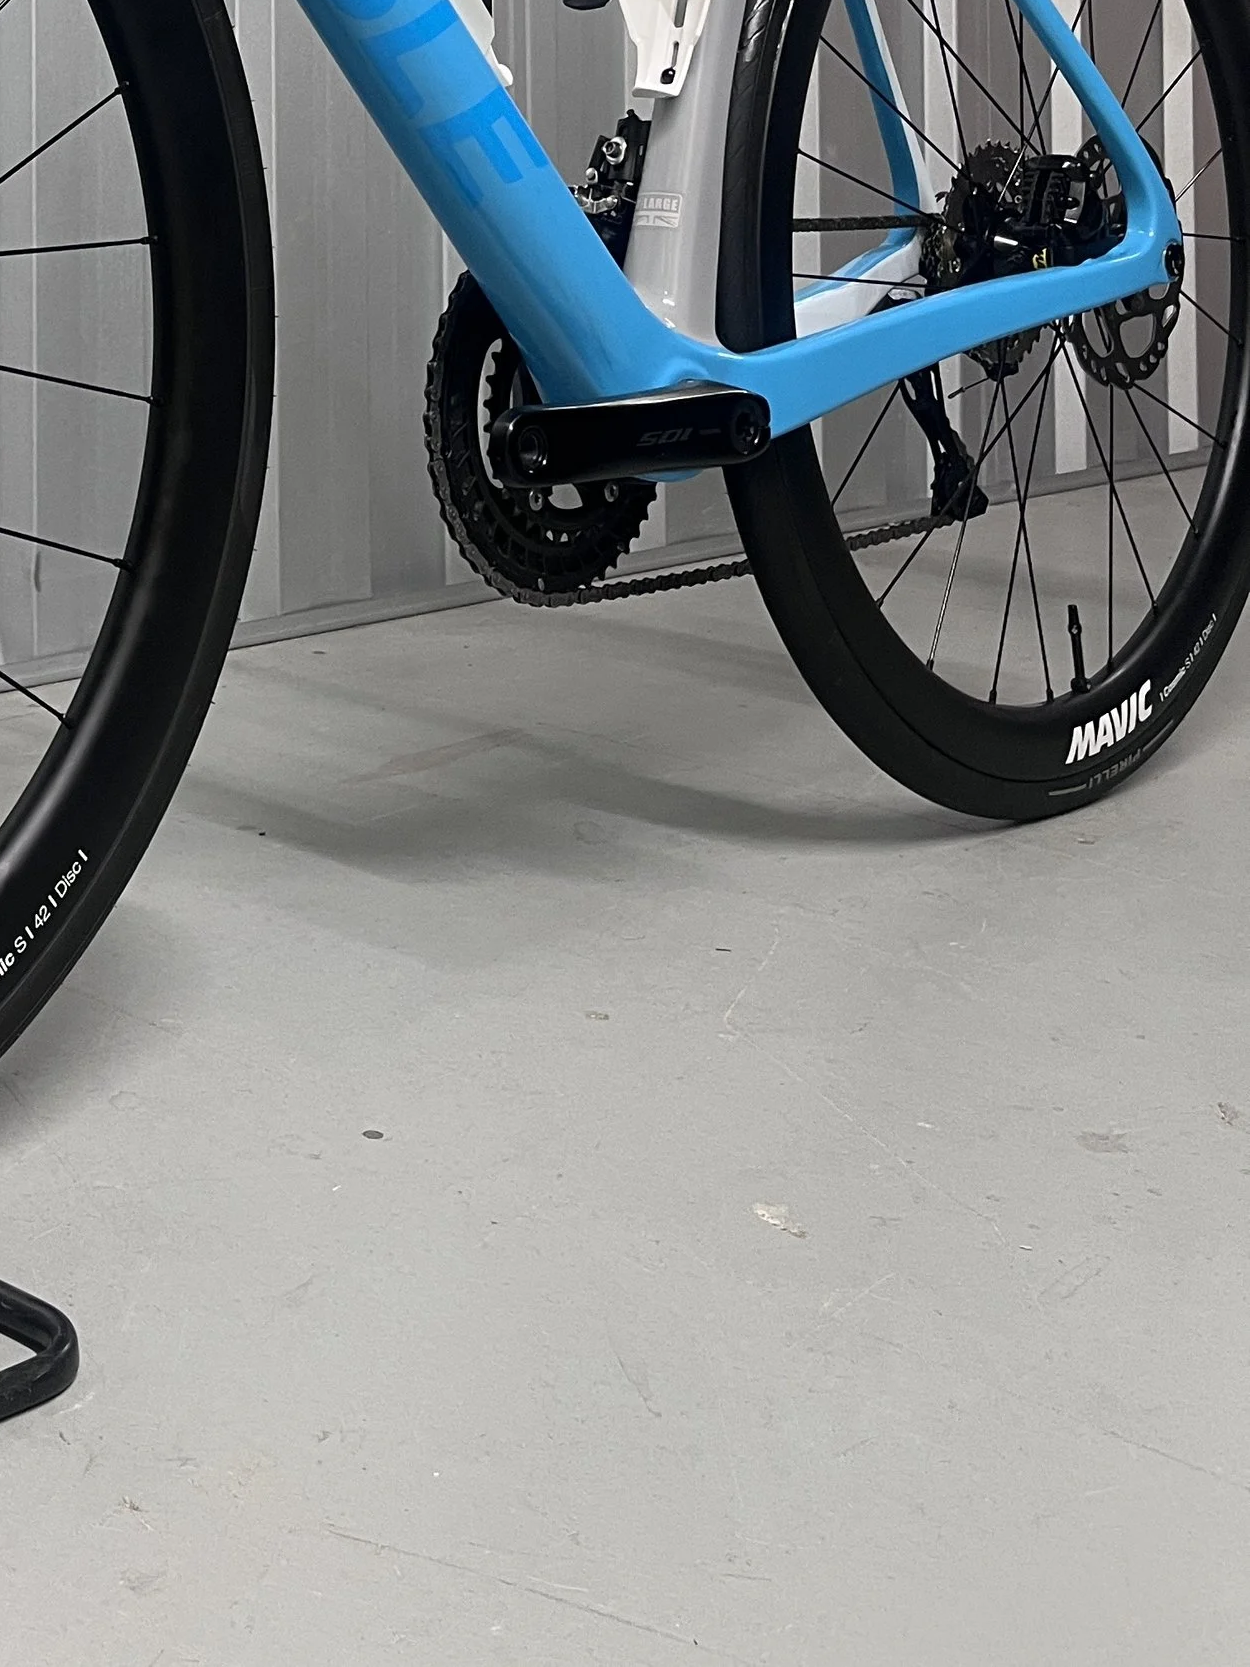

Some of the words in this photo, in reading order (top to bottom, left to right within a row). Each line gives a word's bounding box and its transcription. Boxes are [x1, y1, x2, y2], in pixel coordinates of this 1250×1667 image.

[1065, 679, 1152, 765] MAVIC
[1088, 748, 1142, 789] PIRELLI
[14, 936, 27, 953] S
[34, 905, 51, 928] 42
[54, 861, 82, 898] Disc
